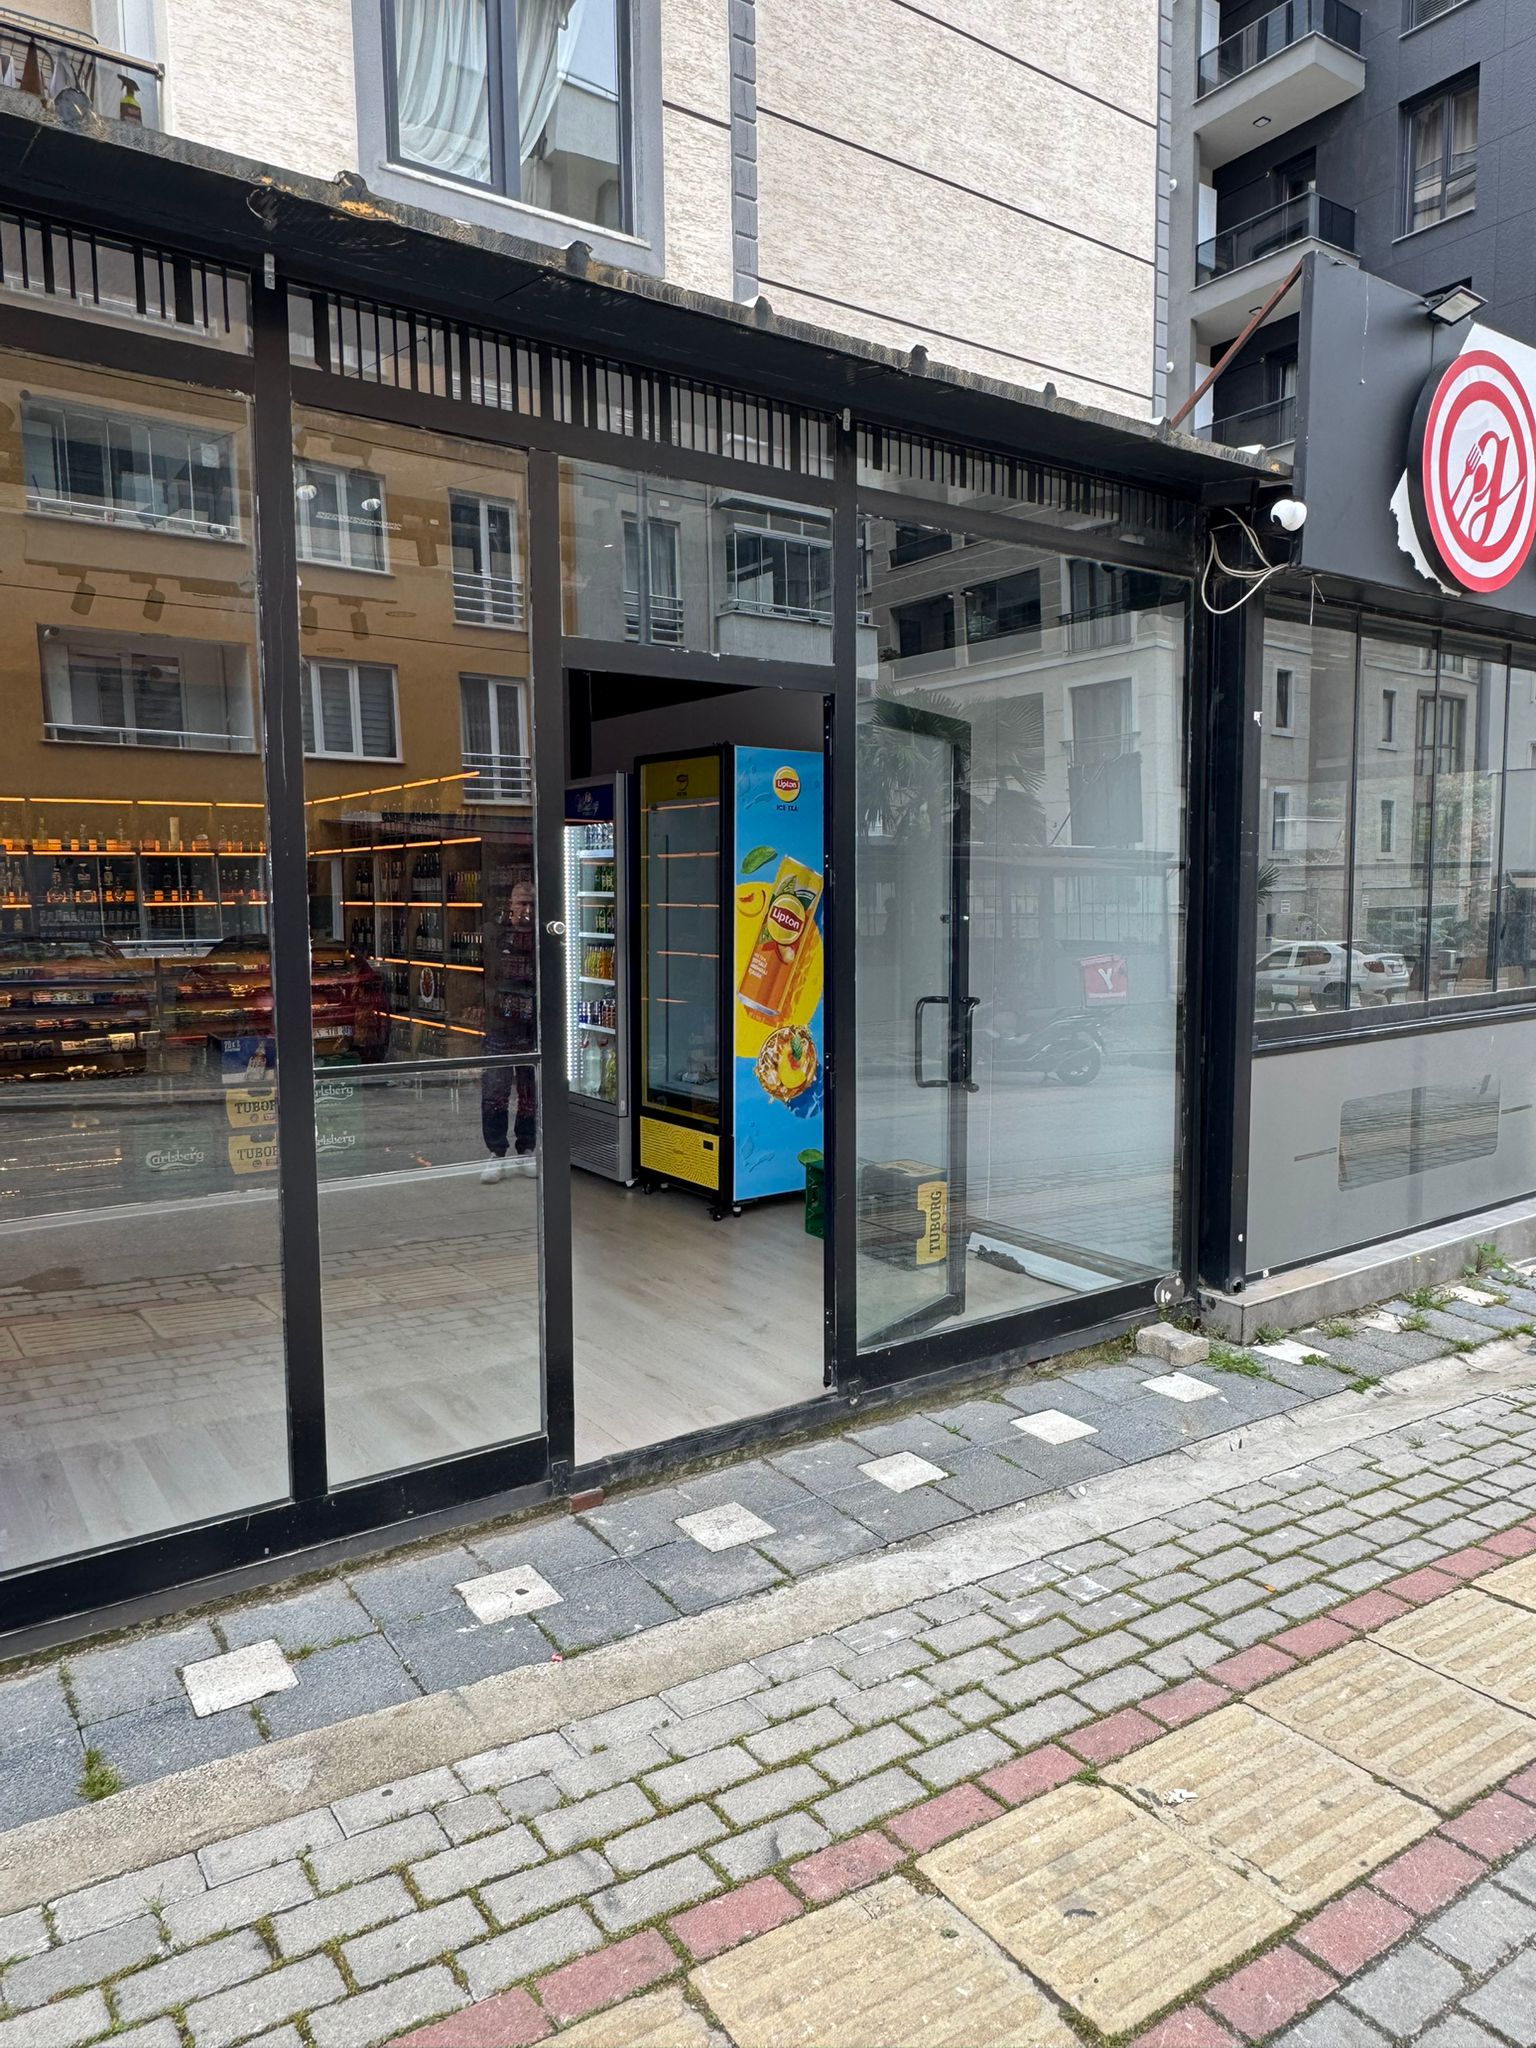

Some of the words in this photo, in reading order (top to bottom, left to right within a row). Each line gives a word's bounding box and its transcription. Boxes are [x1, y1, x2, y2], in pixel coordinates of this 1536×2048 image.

[777, 780, 797, 790] Lipton
[772, 907, 801, 930] Lipton
[314, 1083, 354, 1102] rlsberg
[234, 1100, 277, 1114] TUBOR
[315, 1131, 355, 1151] rlsberg
[145, 1146, 205, 1170] Carlsberg
[236, 1146, 278, 1161] TUBOR
[929, 1190, 942, 1254] TUBORG
